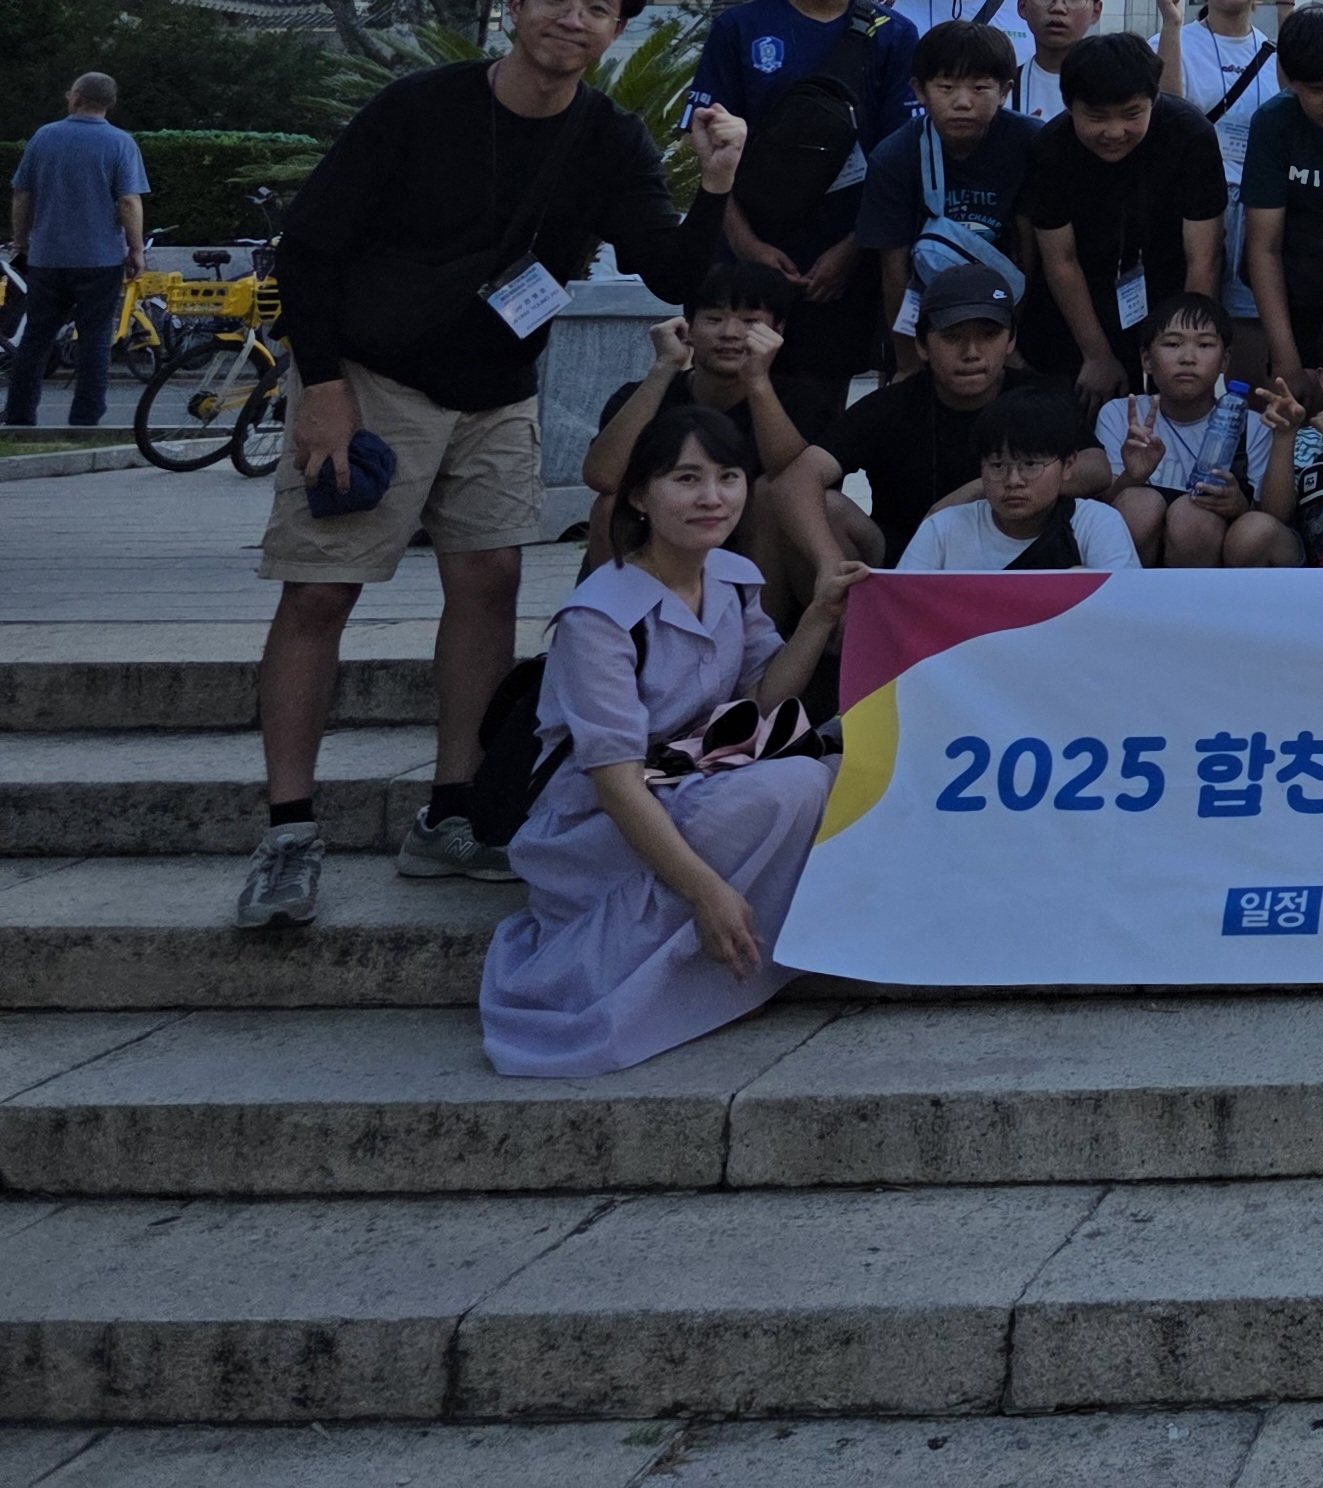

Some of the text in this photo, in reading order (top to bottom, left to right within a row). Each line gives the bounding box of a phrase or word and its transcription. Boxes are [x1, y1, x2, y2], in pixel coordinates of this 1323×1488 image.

[945, 189, 998, 206] HLETIC
[936, 735, 1167, 813] 2025
[1239, 890, 1308, 928] 일정
